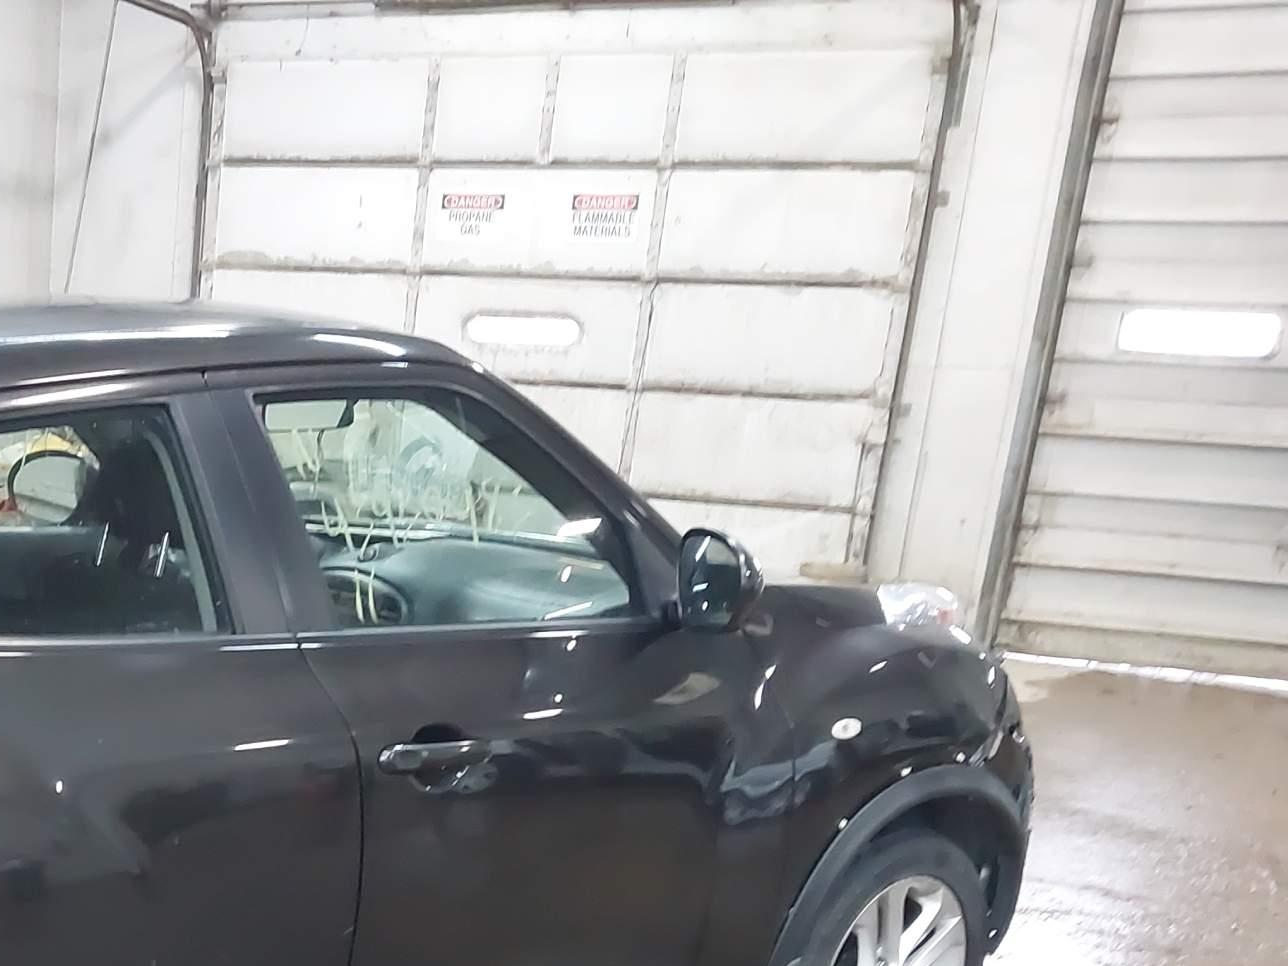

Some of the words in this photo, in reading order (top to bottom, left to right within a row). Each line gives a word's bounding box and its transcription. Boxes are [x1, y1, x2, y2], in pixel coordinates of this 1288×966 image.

[450, 195, 496, 209] DANGER
[581, 195, 629, 209] DANGER
[449, 210, 494, 223] PROPANE
[572, 211, 634, 224] FLAMMABLE
[460, 223, 481, 236] GAS
[573, 225, 631, 238] MATERIALS
